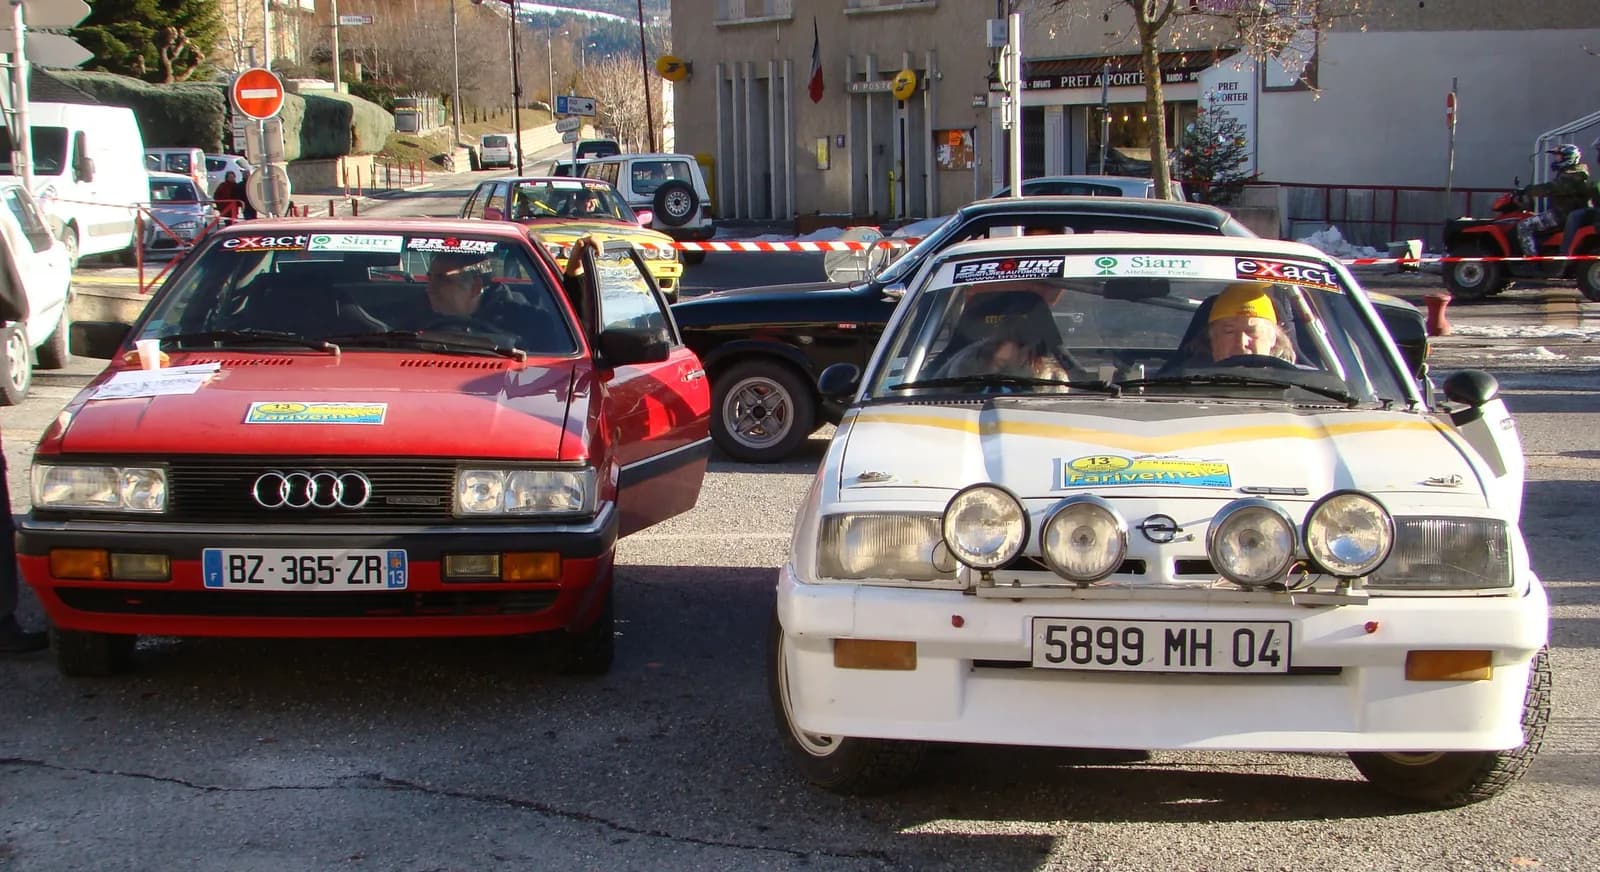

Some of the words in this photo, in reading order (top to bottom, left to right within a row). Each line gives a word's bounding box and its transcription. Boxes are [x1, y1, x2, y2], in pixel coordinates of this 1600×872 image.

[1061, 75, 1091, 88] PRET
[1107, 72, 1145, 86] PORTE
[1218, 82, 1239, 91] PRET
[1216, 93, 1248, 102] ORTER
[223, 235, 307, 249] exact
[341, 235, 393, 246] Siarr
[1130, 256, 1192, 268] Siarr
[965, 273, 1050, 282] www.broum.fr
[1236, 260, 1338, 286] exact
[1087, 456, 1110, 465] 13
[1069, 466, 1227, 484] Farivernale
[210, 572, 217, 582] F
[389, 570, 405, 585] 13
[1044, 625, 1145, 667] 5899
[1163, 628, 1213, 667] MH
[1232, 627, 1281, 668] 04
